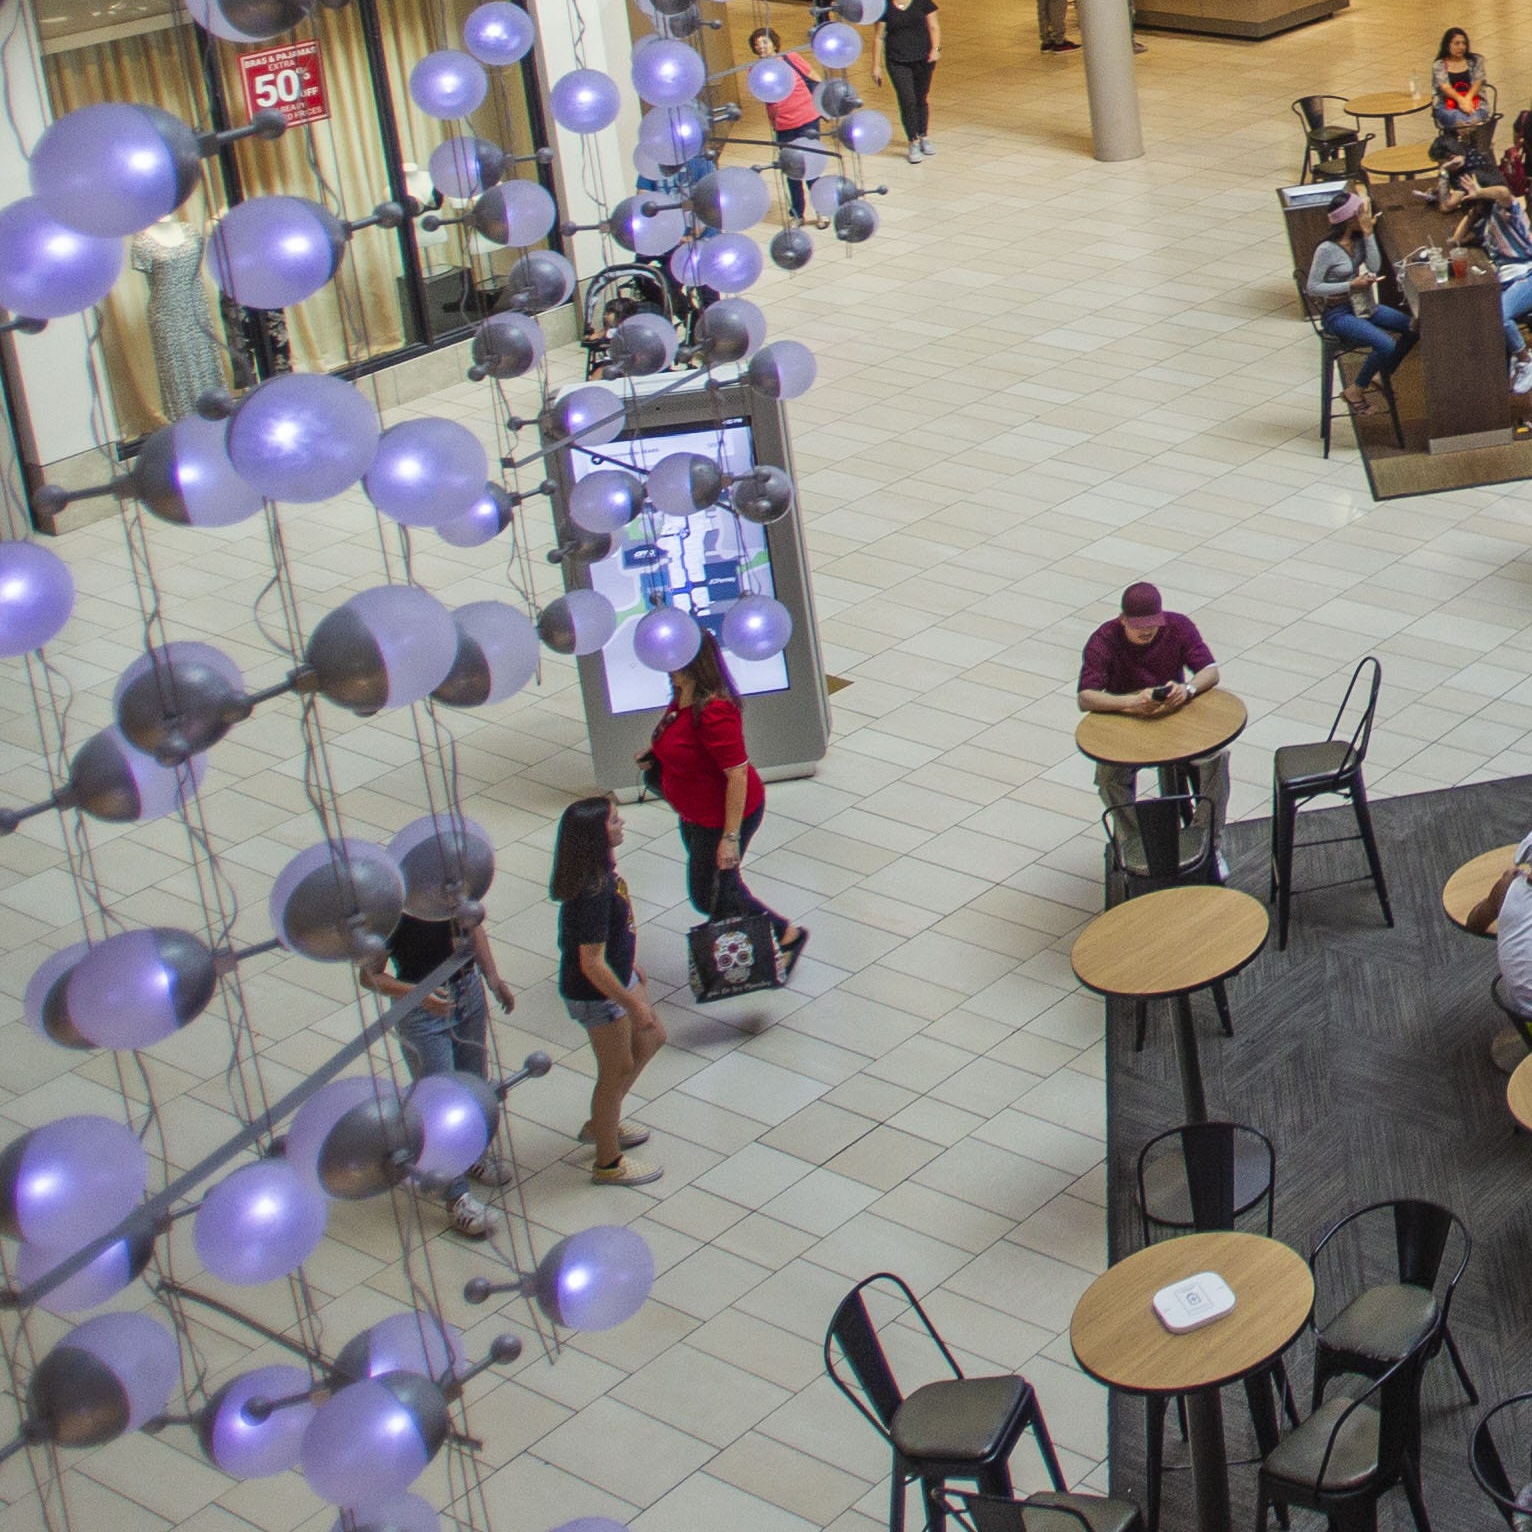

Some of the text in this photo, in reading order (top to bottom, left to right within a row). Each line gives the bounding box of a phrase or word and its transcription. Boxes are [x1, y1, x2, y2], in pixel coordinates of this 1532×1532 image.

[243, 56, 268, 69] BRAS
[276, 46, 317, 61] PAJAMAS
[268, 59, 296, 72] EXTRA
